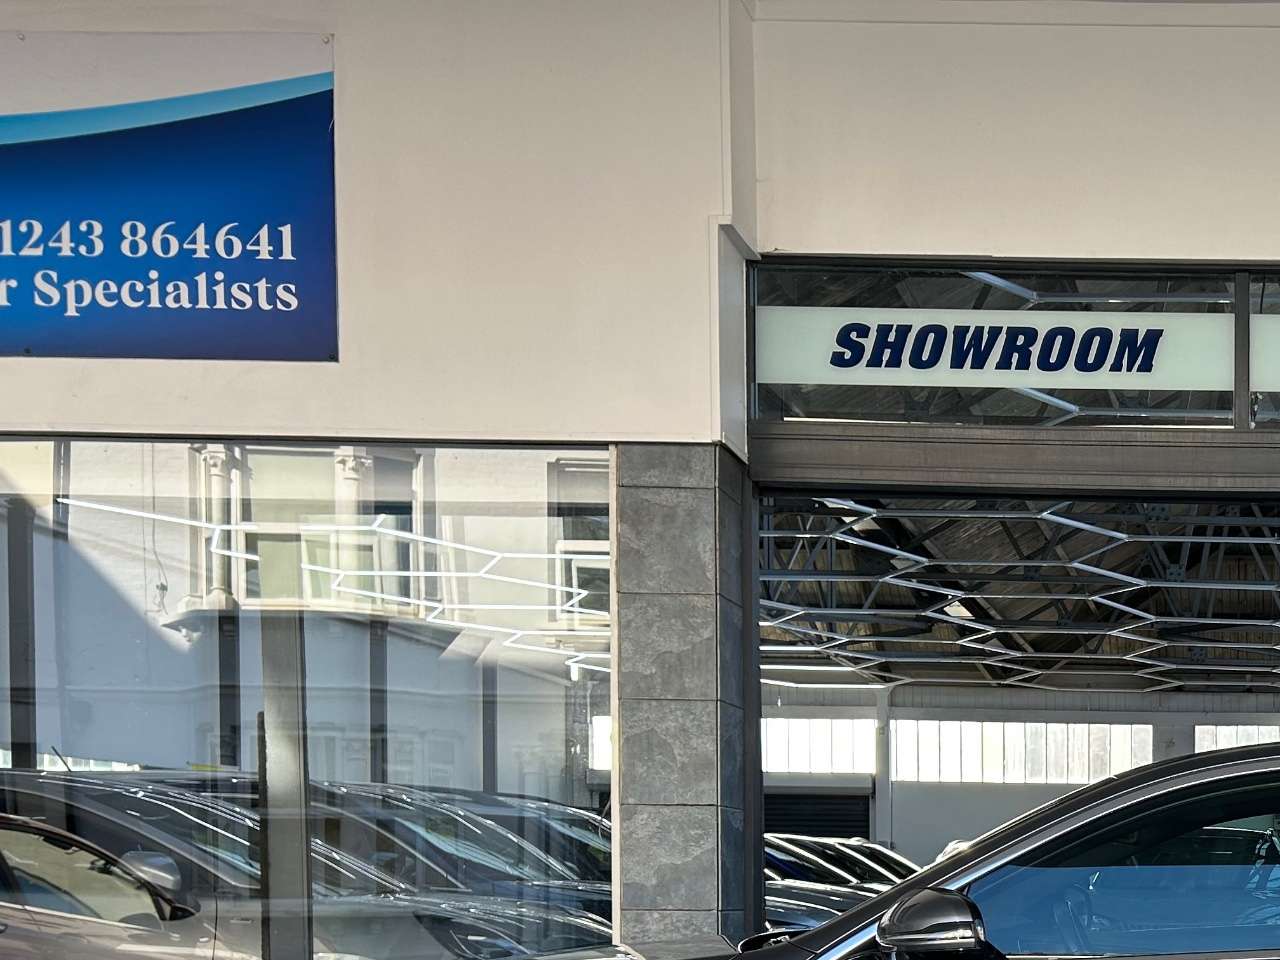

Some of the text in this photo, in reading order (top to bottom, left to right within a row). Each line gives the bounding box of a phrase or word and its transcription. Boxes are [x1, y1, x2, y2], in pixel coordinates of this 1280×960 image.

[0, 220, 297, 261] 1243 864641
[34, 269, 299, 317] Specialists
[829, 322, 1165, 373] SHOWROOM
